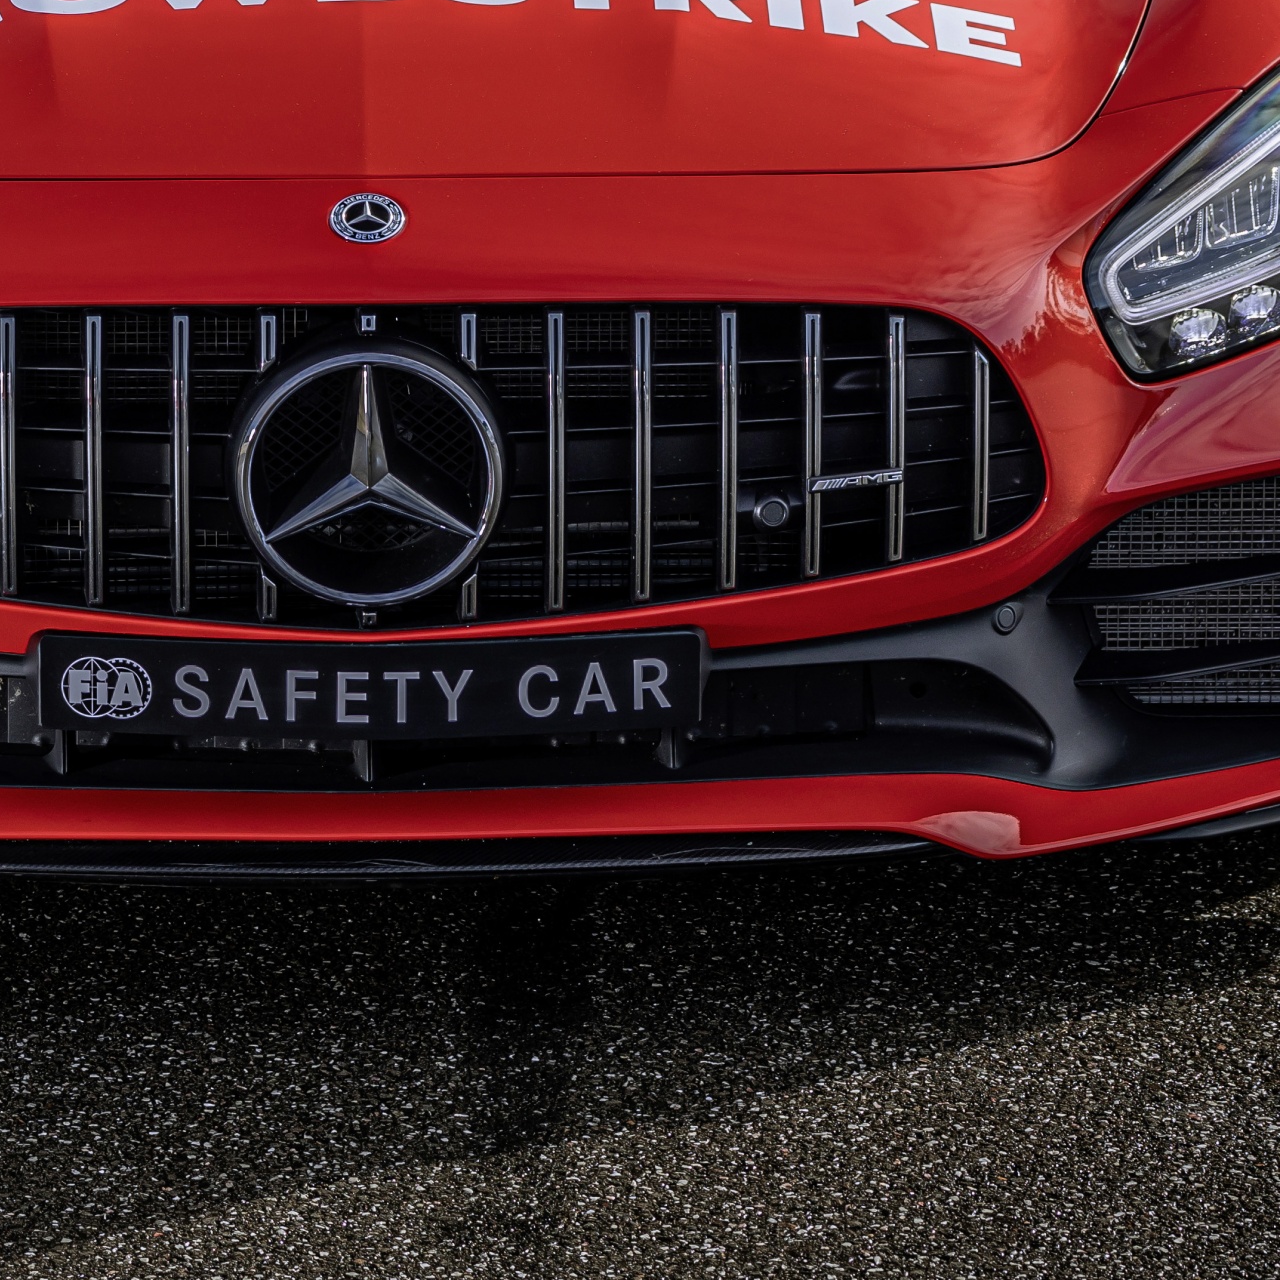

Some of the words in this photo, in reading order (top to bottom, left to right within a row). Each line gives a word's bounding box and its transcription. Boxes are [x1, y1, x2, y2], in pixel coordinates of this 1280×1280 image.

[344, 195, 390, 205] MERCEDES
[173, 664, 474, 724] SAFETY
[518, 657, 672, 718] CAR
